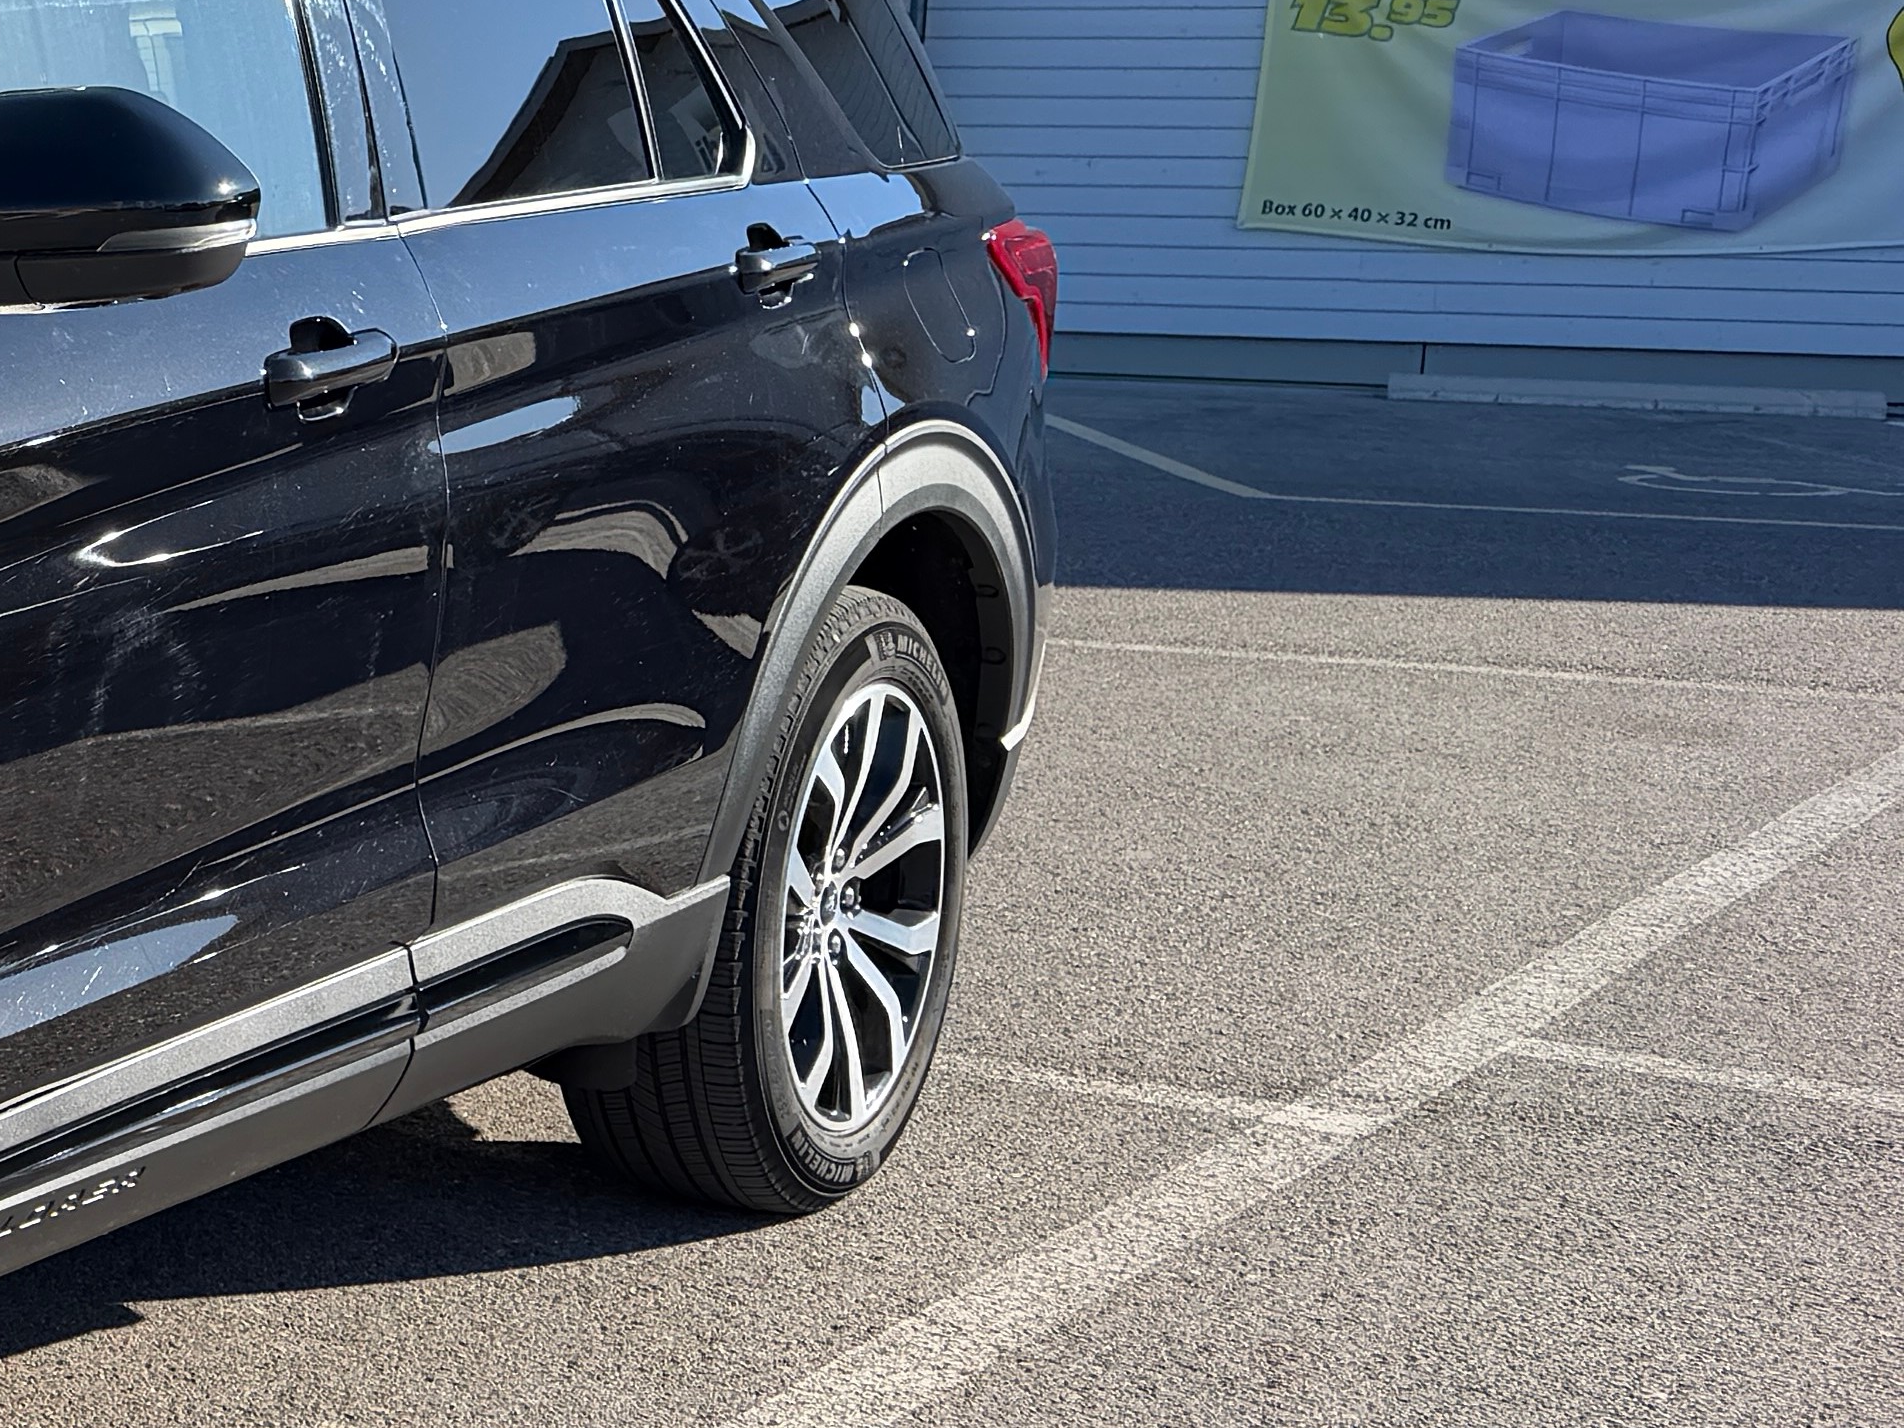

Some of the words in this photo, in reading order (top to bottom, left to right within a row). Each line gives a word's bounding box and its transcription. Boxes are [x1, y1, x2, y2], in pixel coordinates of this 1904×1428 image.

[1261, 199, 1297, 216] Box
[1301, 202, 1326, 219] 60
[1347, 207, 1373, 223] 40
[1394, 211, 1419, 228] 32
[1424, 217, 1452, 230] cm
[896, 633, 950, 701] MICHELIN
[792, 1129, 855, 1183] MICHELIN
